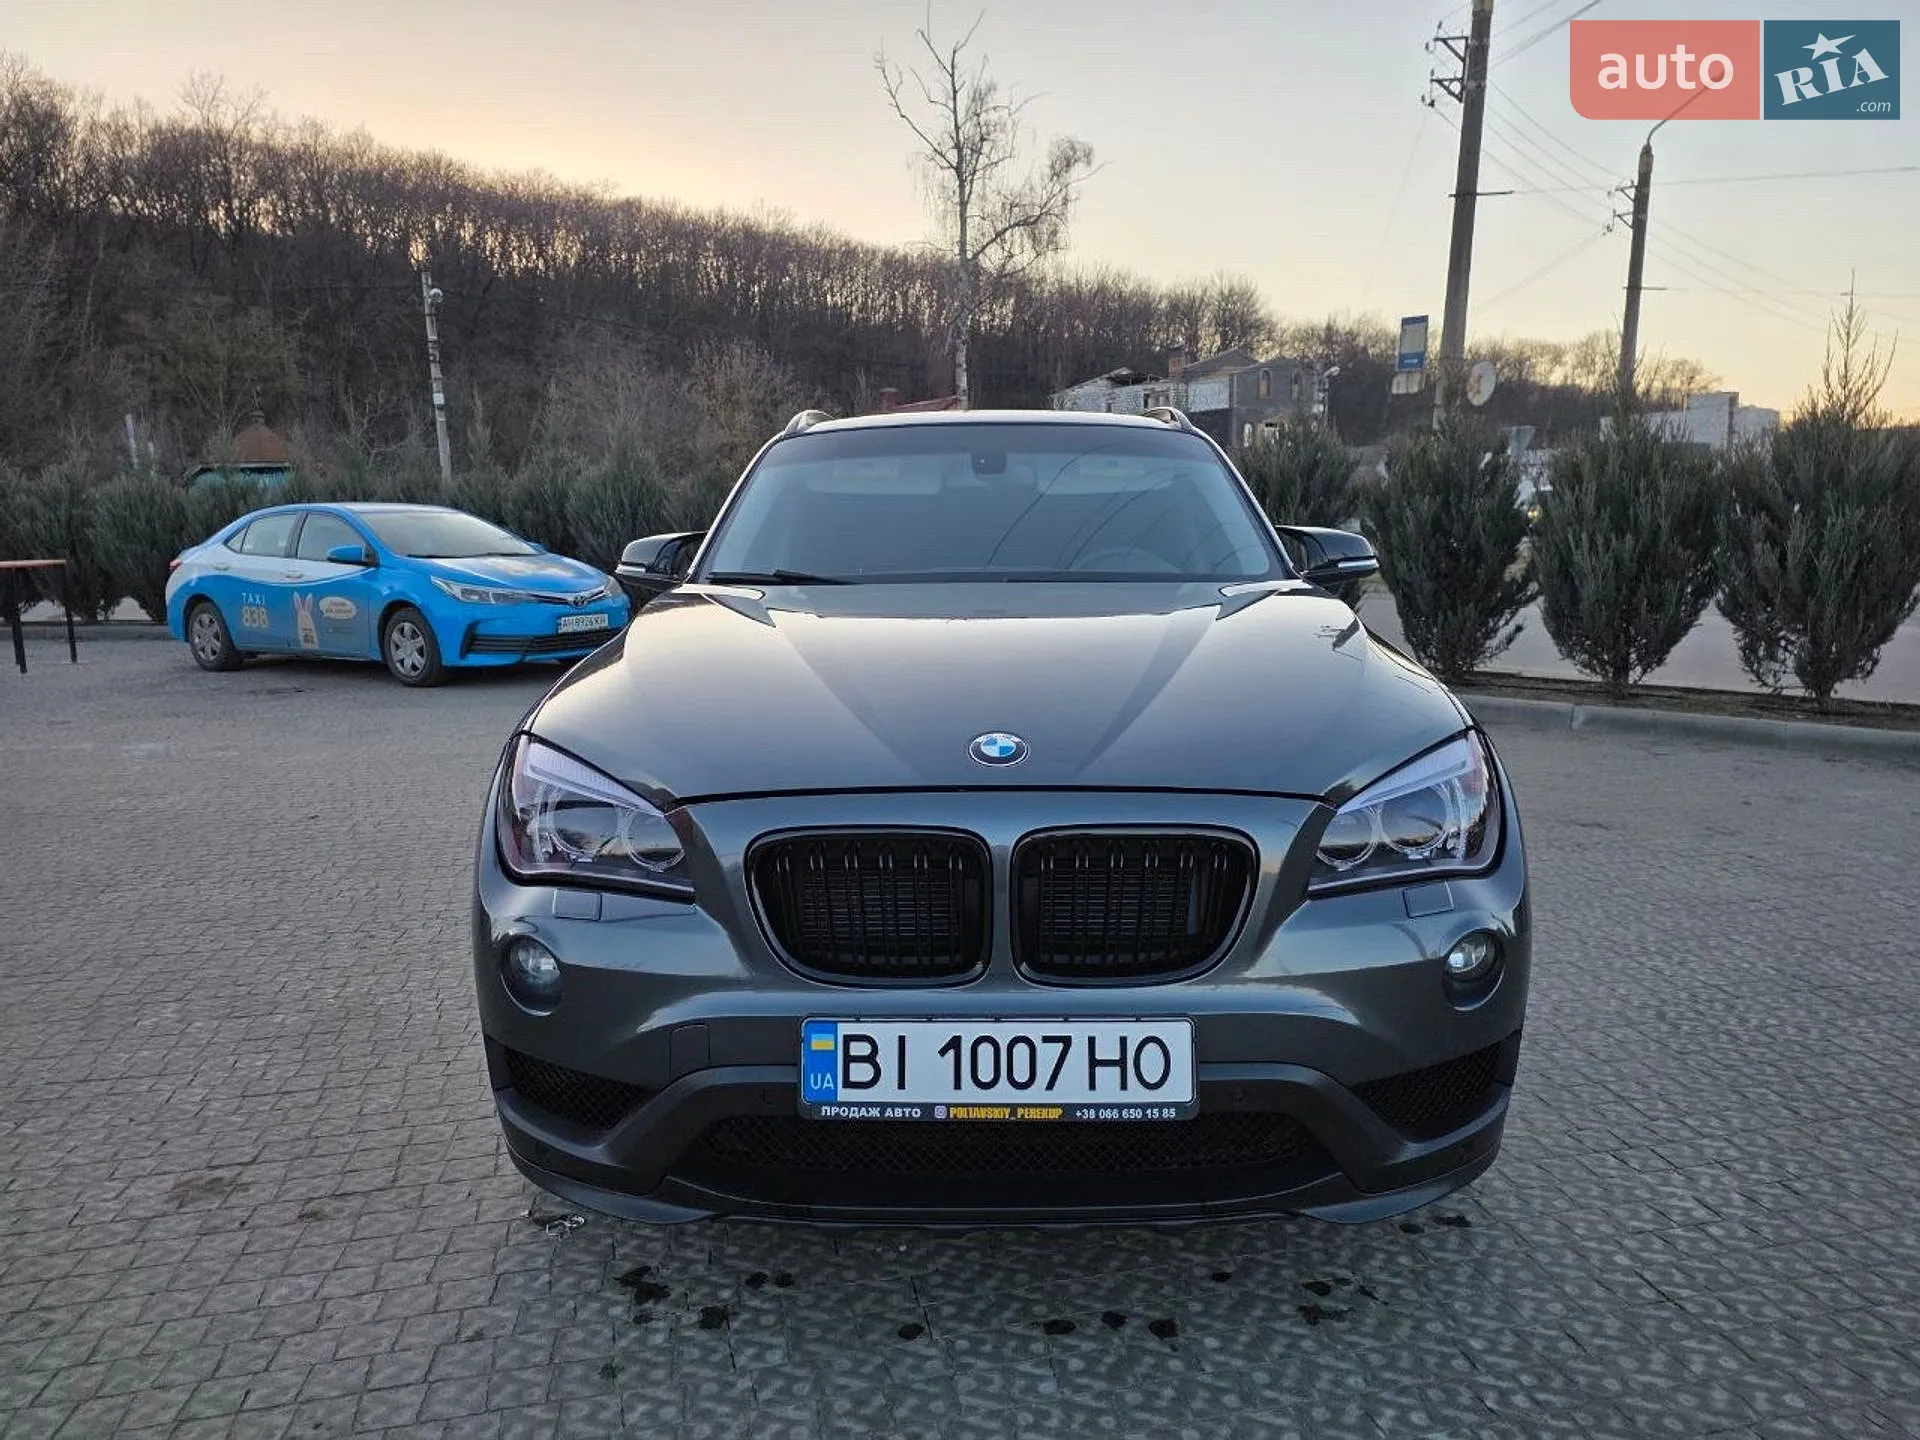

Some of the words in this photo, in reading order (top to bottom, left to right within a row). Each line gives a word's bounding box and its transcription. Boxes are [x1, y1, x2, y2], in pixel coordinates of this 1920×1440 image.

[241, 593, 265, 605] TAXI
[842, 1034, 906, 1090] BI
[937, 1035, 1072, 1090] 1007
[1087, 1035, 1171, 1091] HO
[810, 1072, 835, 1090] UA
[821, 1106, 881, 1118] ПРОДАЖ
[884, 1107, 921, 1118] АВТО
[1075, 1108, 1096, 1119] +38
[1122, 1108, 1142, 1119] 650
[1145, 1107, 1159, 1119] 15
[1162, 1107, 1176, 1118] 85
